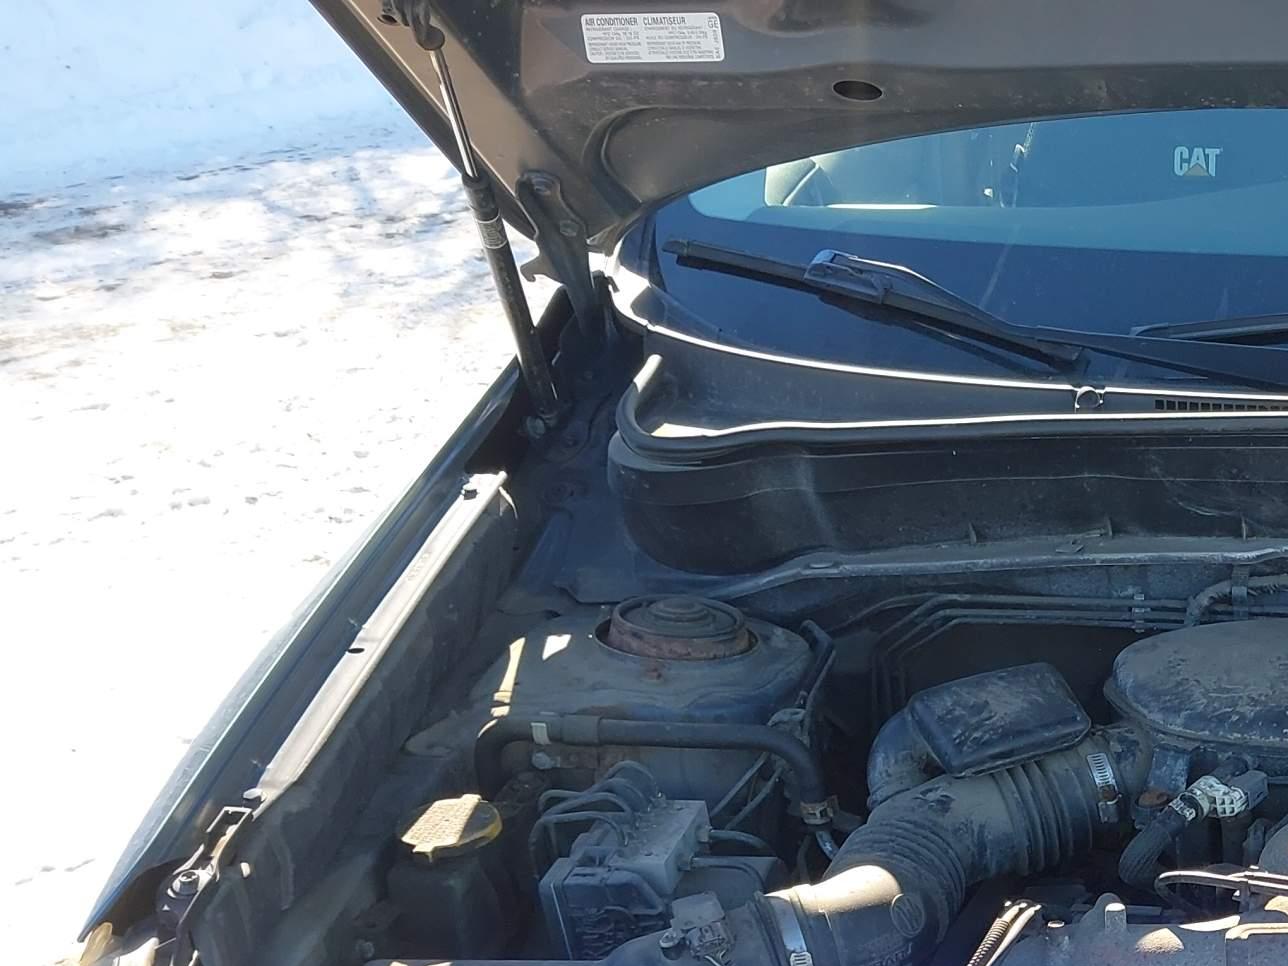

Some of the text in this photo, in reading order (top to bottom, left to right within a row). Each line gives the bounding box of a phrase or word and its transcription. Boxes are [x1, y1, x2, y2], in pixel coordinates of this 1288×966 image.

[585, 16, 638, 26] AIR CONDITIONER
[642, 16, 687, 26] CLIMATISEUR
[707, 20, 719, 29] GE
[1174, 146, 1220, 176] CAT
